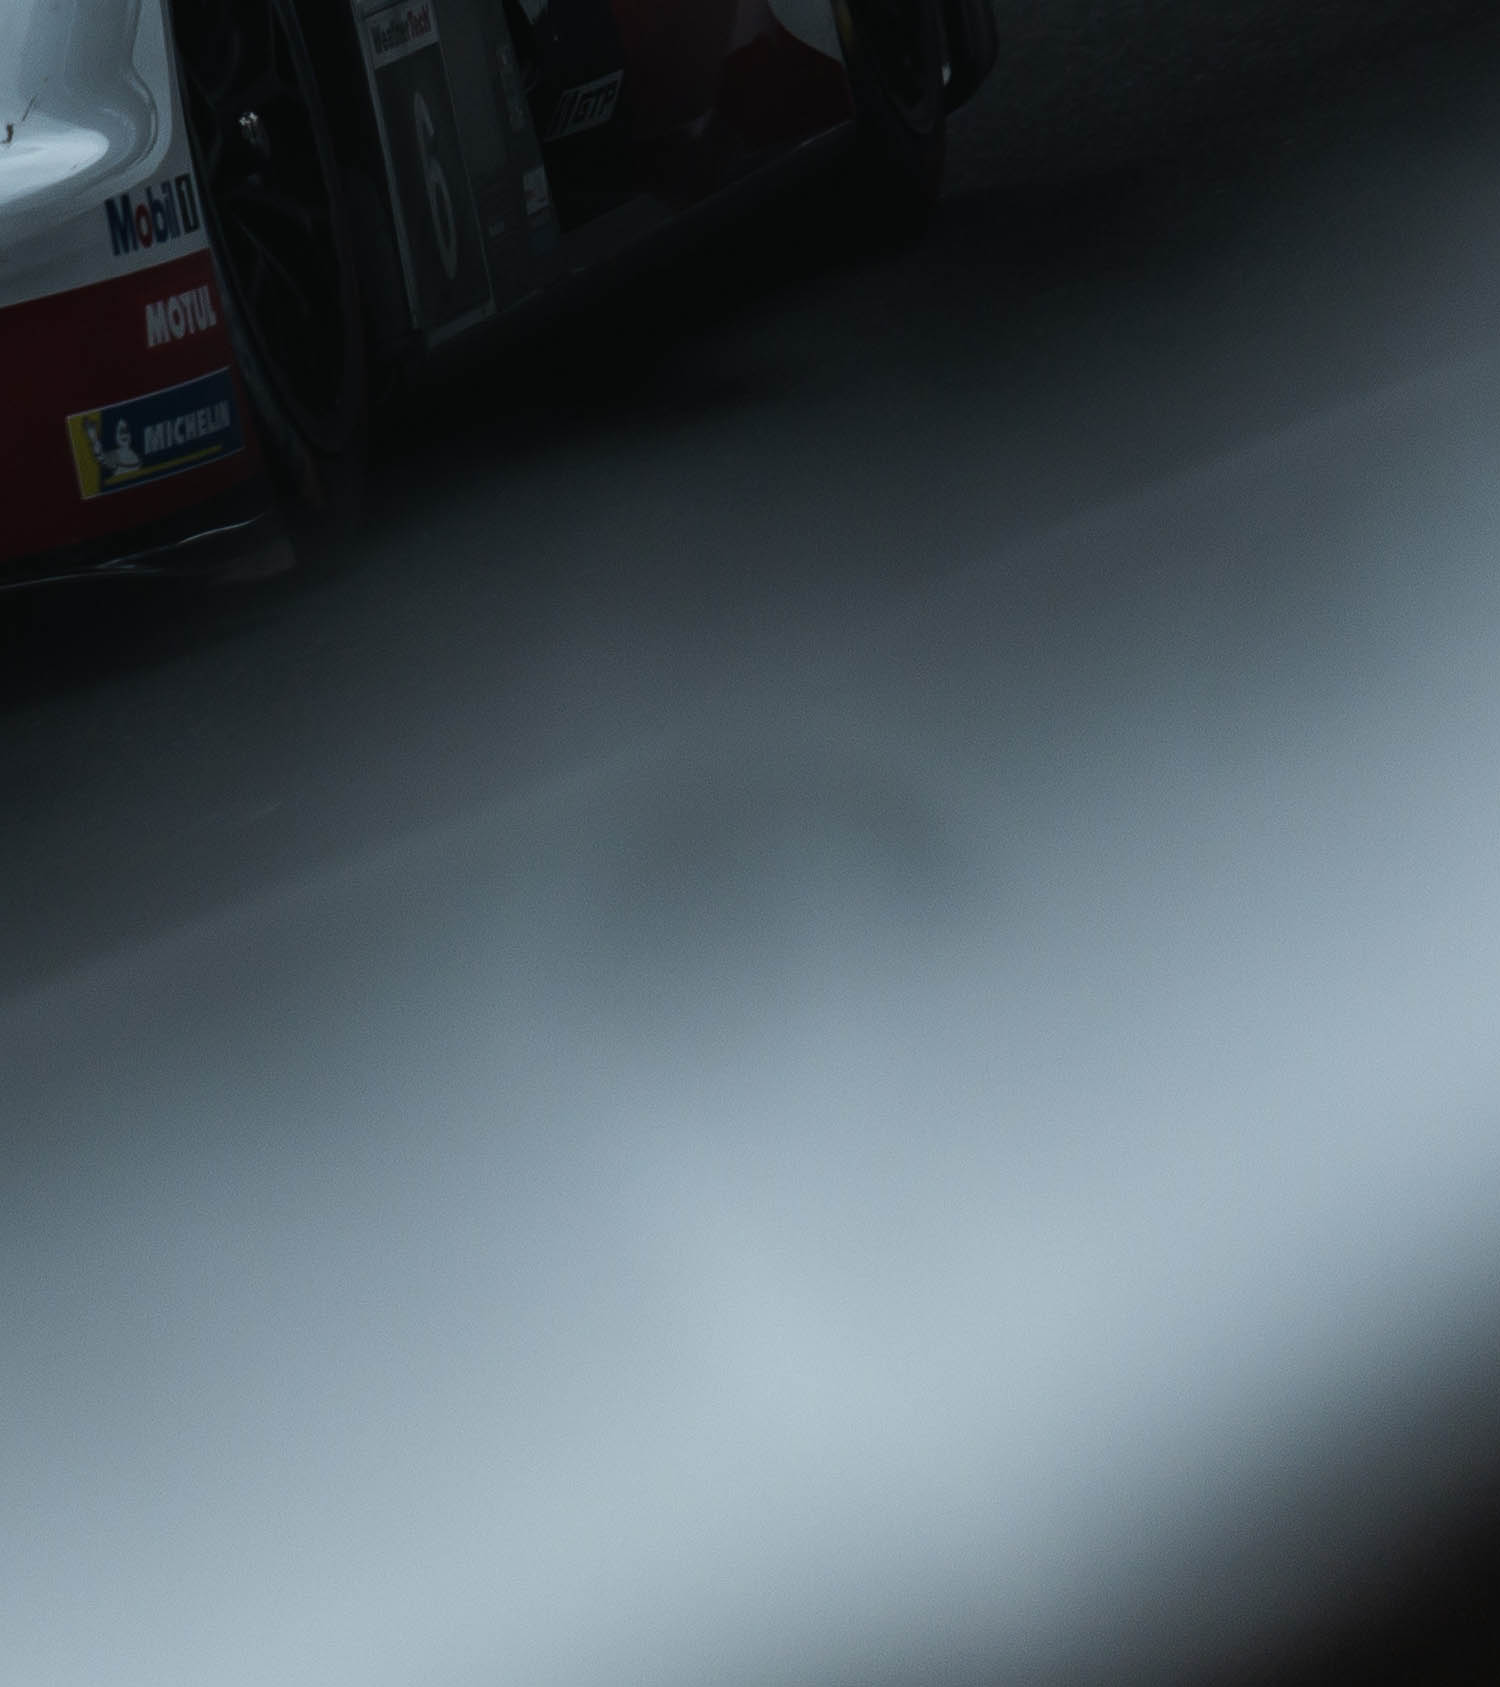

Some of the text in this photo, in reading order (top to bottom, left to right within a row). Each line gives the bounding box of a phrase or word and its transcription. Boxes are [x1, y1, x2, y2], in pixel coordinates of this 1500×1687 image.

[413, 88, 458, 280] 6
[104, 182, 181, 257] Mobil
[144, 284, 217, 349] MOTUL
[142, 399, 231, 456] MICHELIN
